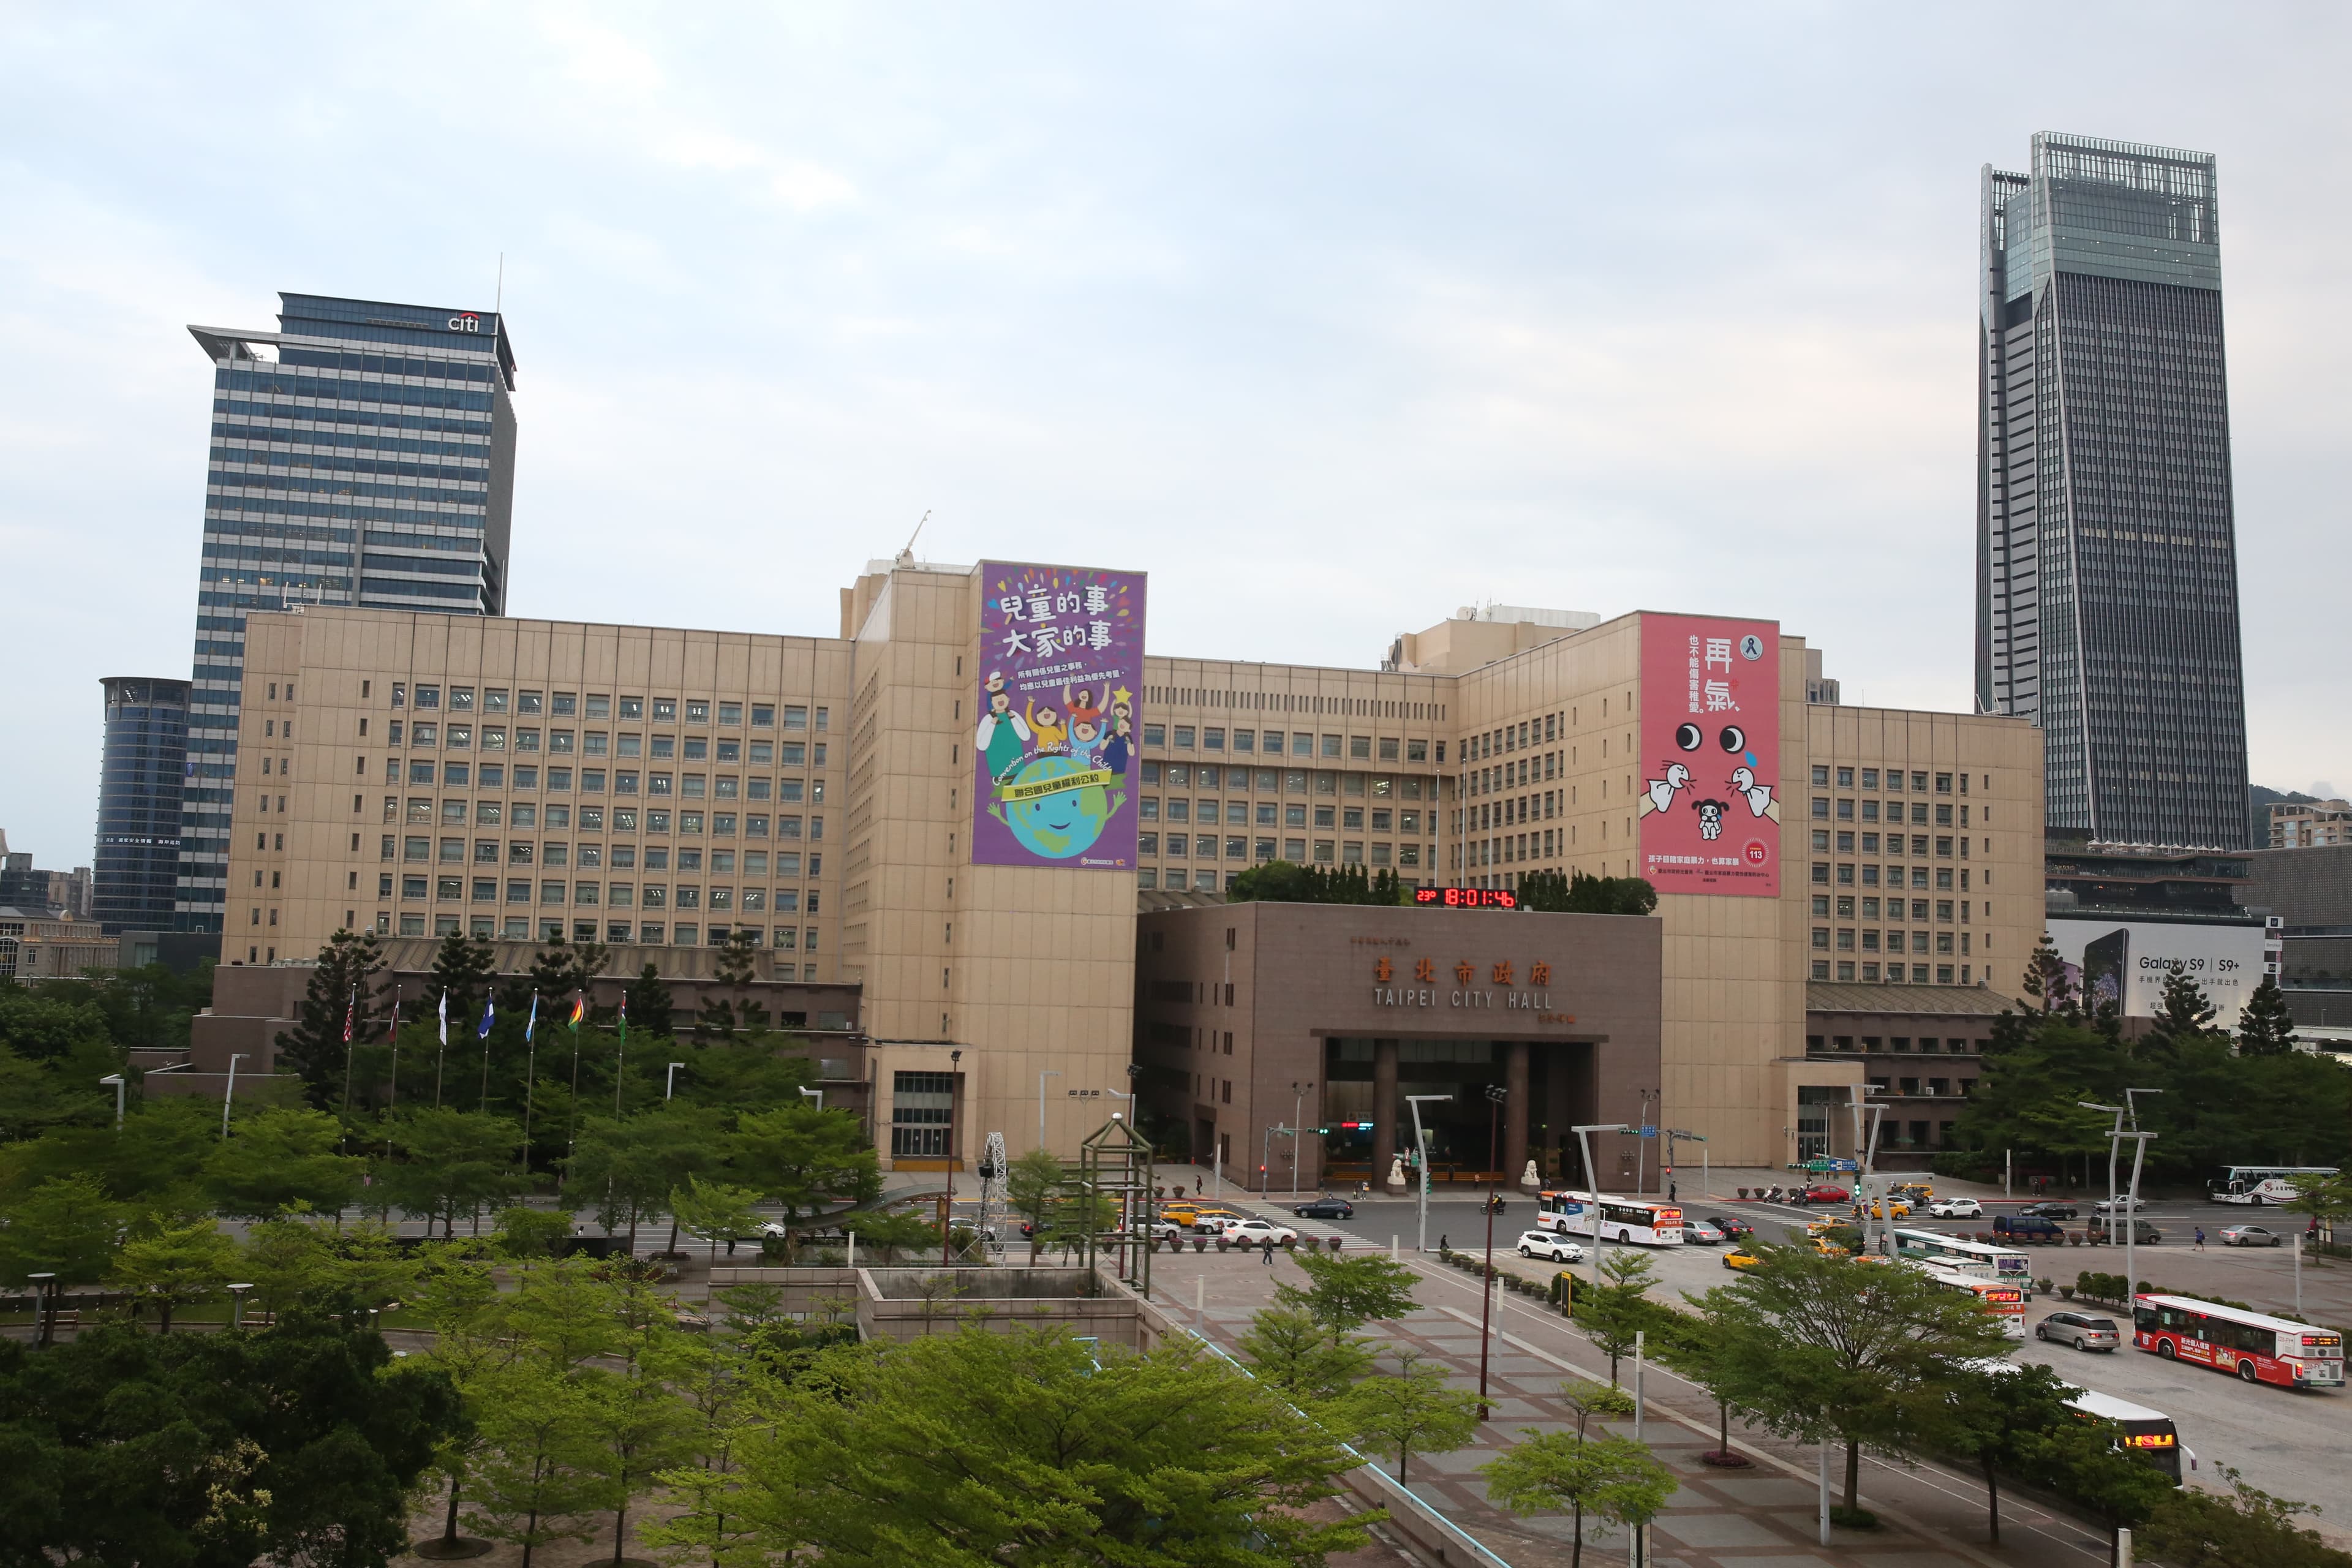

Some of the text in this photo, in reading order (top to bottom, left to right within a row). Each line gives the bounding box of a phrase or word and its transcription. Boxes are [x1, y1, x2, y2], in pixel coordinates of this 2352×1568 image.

[448, 312, 480, 333] citi
[1000, 584, 1108, 623] 兒童的事
[1003, 620, 1112, 658] 大家的事
[992, 756, 1023, 786] Convention
[1034, 745, 1045, 755] the
[1047, 741, 1069, 754] Rights
[1070, 746, 1079, 756] of
[1080, 749, 1091, 759] the
[1092, 755, 1112, 771] Child
[1014, 774, 1099, 797] 聯合國兒童權利公約
[1446, 888, 1515, 907] 18:01:46
[2139, 957, 2239, 973] Galaxy S9 S9+
[1374, 988, 1552, 1009] TAIPEI CITY HALL
